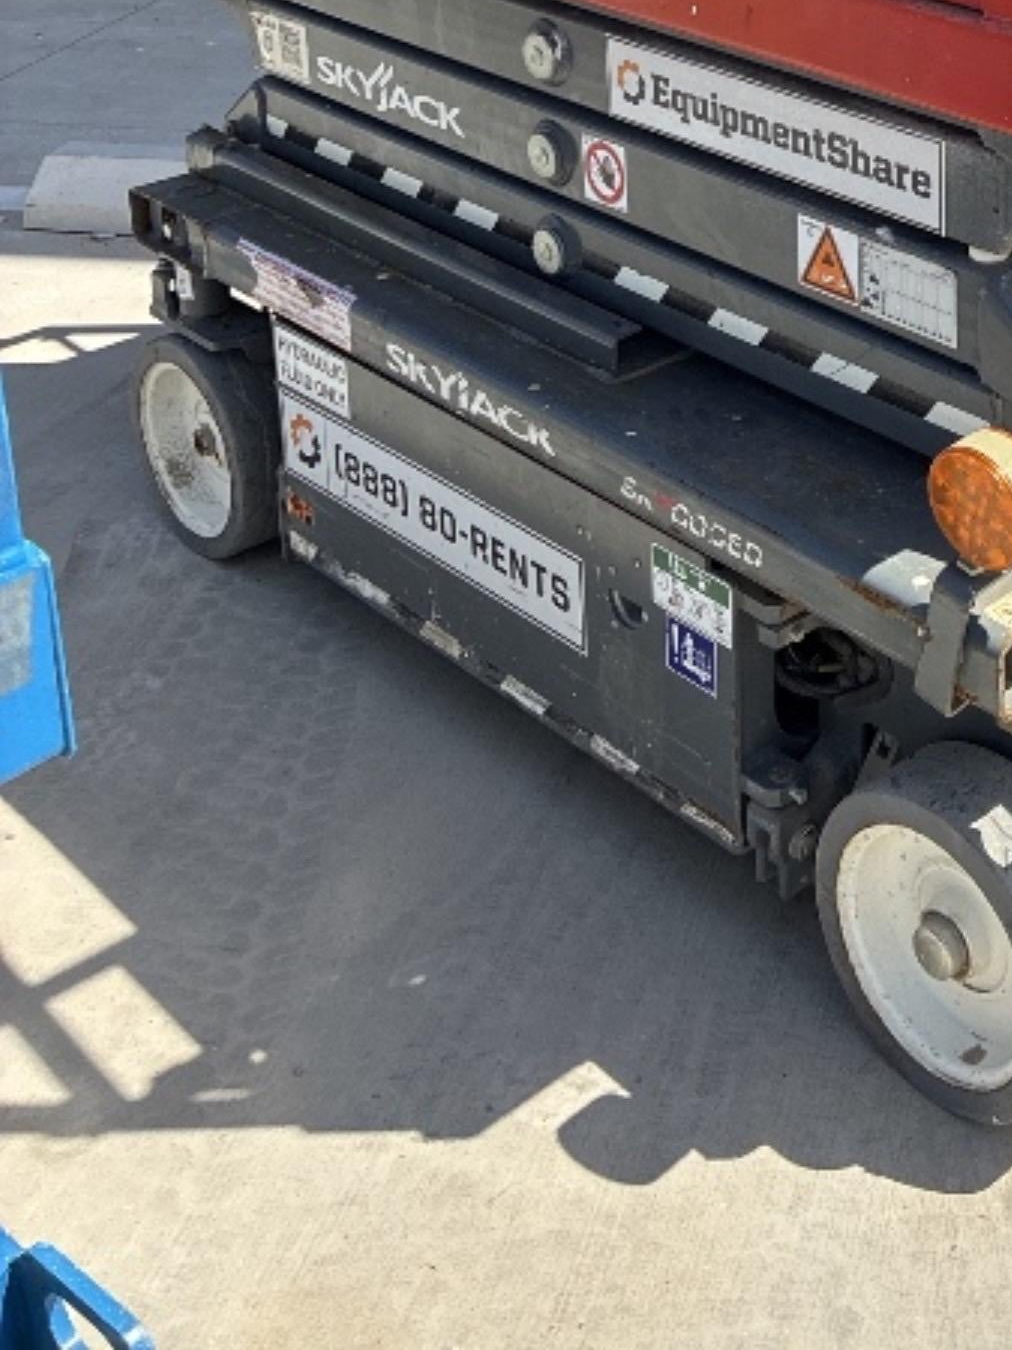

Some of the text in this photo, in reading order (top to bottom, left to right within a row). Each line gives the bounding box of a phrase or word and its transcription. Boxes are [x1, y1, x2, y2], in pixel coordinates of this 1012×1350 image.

[316, 55, 466, 139] SKYJACK
[650, 71, 932, 200] EquipmentShare
[385, 342, 556, 457] SKYJACK
[334, 442, 409, 518] (888)
[418, 495, 572, 614] 80-RENTS
